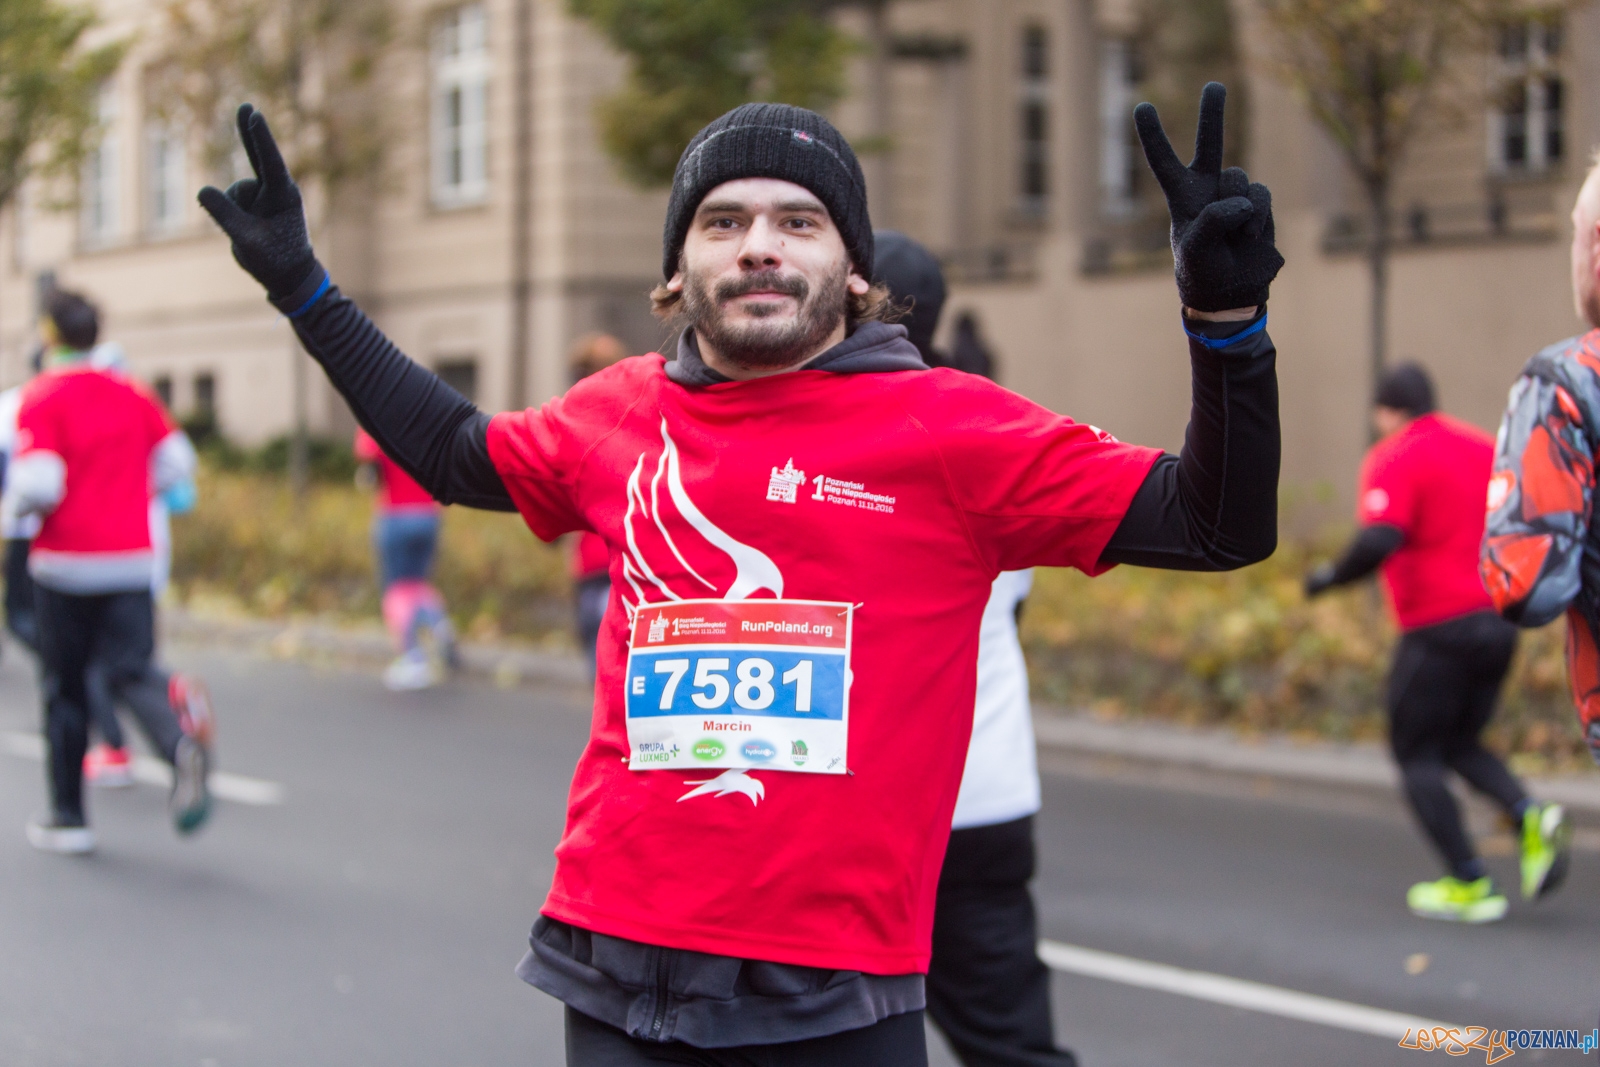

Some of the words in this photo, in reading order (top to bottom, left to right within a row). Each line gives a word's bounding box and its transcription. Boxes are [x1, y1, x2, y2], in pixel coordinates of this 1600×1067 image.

[811, 474, 825, 501] 1
[825, 477, 864, 491] Poznański
[824, 484, 841, 495] Bieg
[841, 488, 896, 504] Niepodległości
[857, 500, 894, 514] 11.11.2016
[671, 617, 680, 636] 1
[741, 620, 833, 638] RunPoland.org
[632, 676, 645, 695] E
[654, 657, 813, 712] 7581
[703, 720, 752, 732] Marcin
[639, 743, 664, 752] GRUPA
[696, 747, 723, 756] energy
[639, 753, 669, 762] LUXMED
